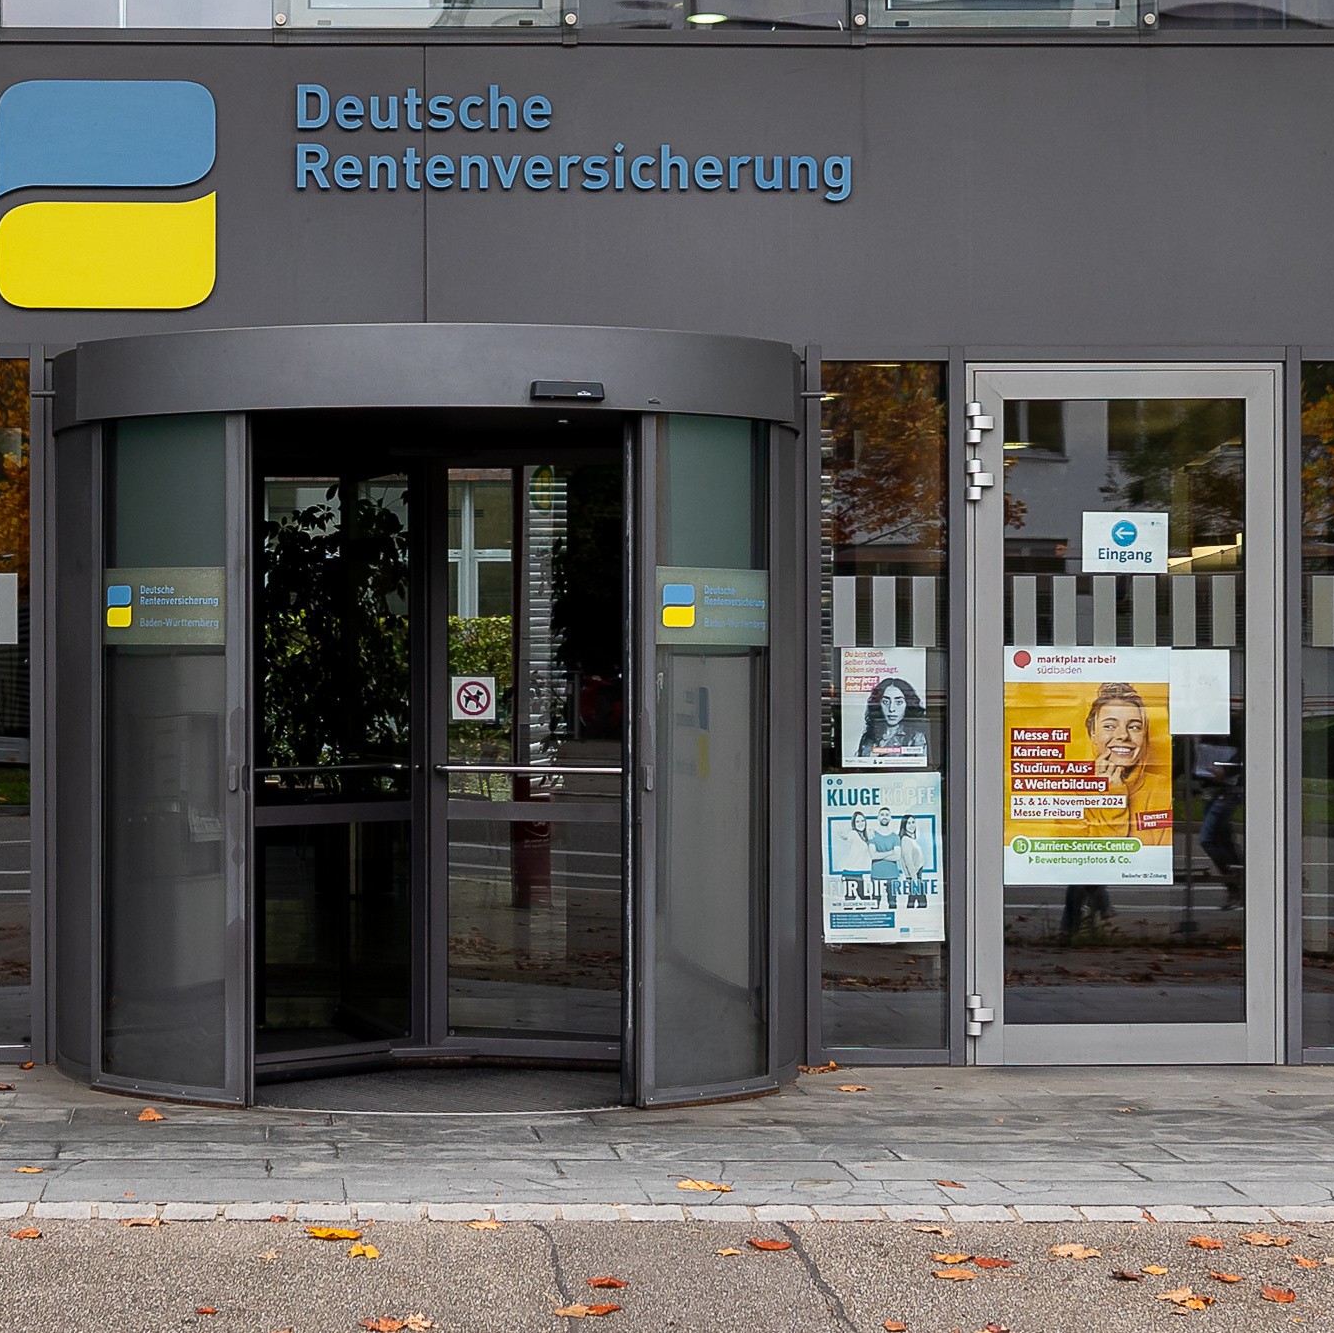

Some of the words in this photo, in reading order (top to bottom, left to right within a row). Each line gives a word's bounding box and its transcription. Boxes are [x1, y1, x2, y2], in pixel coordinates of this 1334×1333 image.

[296, 84, 554, 131] Deutsche
[296, 142, 855, 203] Rentenversicherung
[1098, 547, 1153, 564] Eingang
[139, 584, 175, 594] Deutsche
[139, 595, 219, 607] Rentenversicherung
[139, 617, 219, 630] Baden-Württemberg
[1037, 655, 1086, 666] marktplatz
[1087, 654, 1116, 664] arbeit
[1037, 665, 1082, 675] südbaden
[1013, 729, 1050, 741] Messe
[1051, 729, 1069, 741] für
[1013, 746, 1063, 759] Karriere,
[1013, 762, 1065, 775] Studium,
[1066, 763, 1093, 774] Aus-
[1013, 779, 1024, 790] &
[1025, 778, 1107, 792] Weiterbildung
[827, 788, 881, 807] KLUGE
[1013, 797, 1026, 807] 15.
[1028, 797, 1036, 807] &
[1037, 797, 1051, 807] 16.
[1052, 797, 1100, 807] November
[1101, 797, 1124, 807] 2024
[1013, 808, 1042, 817] Messe
[1043, 808, 1082, 819] Freiburg
[1142, 812, 1169, 822] EINTRITT
[1143, 820, 1157, 829] FREI
[1034, 840, 1135, 851] Karriere-Service-Center
[1035, 856, 1108, 866] Bewerbungsfotos
[1109, 856, 1118, 864] &
[1117, 856, 1132, 864] Co.
[891, 879, 939, 896] RENTE
